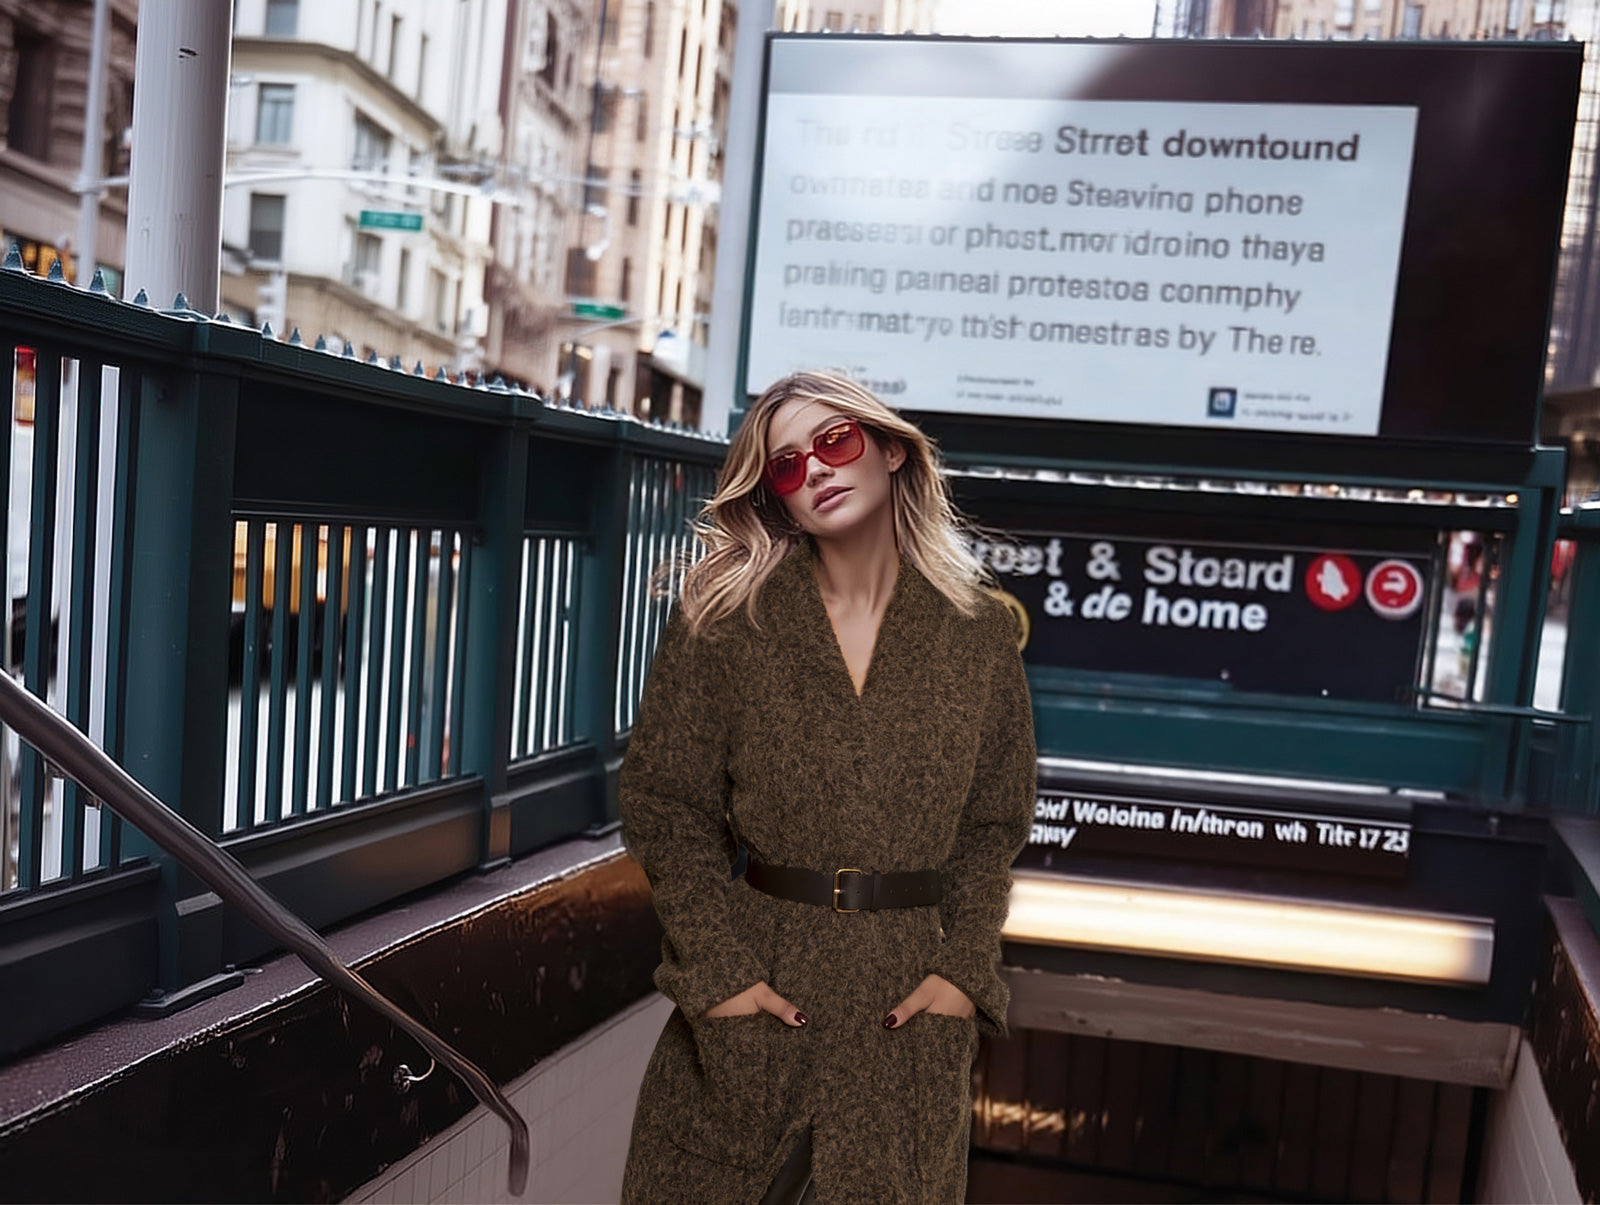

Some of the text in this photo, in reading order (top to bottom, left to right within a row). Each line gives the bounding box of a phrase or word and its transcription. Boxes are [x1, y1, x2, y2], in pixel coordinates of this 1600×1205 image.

[1054, 126, 1150, 156] Strret
[1162, 129, 1361, 162] downtound
[1205, 186, 1305, 217] phone
[1178, 323, 1217, 357] by
[1086, 541, 1121, 582] &
[1143, 546, 1295, 593] Stoard
[1043, 580, 1268, 632] & de home
